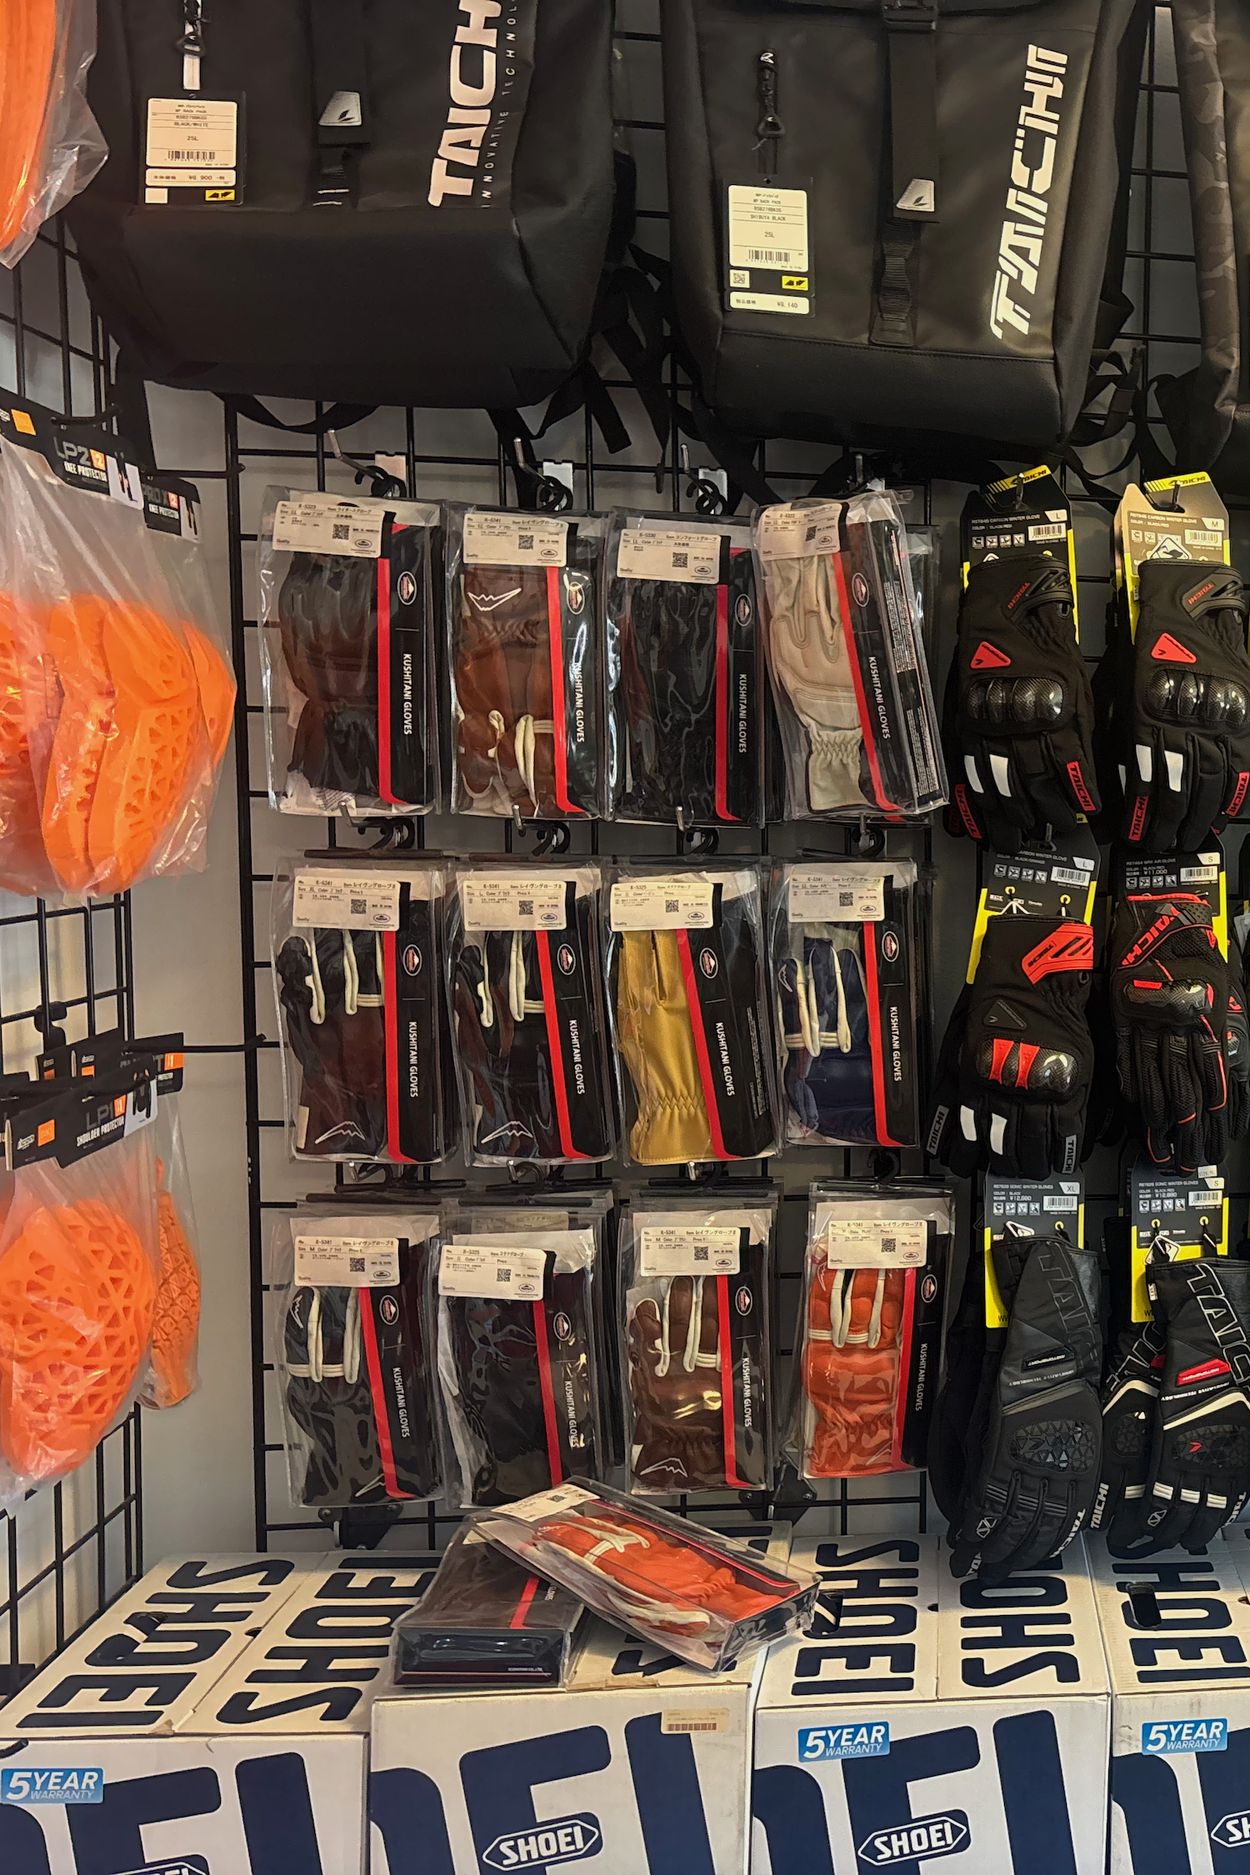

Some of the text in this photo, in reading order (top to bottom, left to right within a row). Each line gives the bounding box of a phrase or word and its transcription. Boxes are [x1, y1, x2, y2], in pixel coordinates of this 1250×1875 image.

[481, 111, 509, 208] INNOVATIVE
[990, 43, 1068, 340] TAICHI
[403, 654, 412, 735] KUSHITANI GLOVES
[576, 710, 584, 742] GLOVES
[739, 674, 747, 753] KUSHITANI GLOVES
[868, 656, 890, 739] KUSHITANI GLOVES
[1070, 764, 1093, 810] TAICHI
[1131, 797, 1146, 840] TAICHI
[1226, 773, 1248, 816] TAICHI
[1028, 944, 1055, 967] TAICHI
[409, 1022, 418, 1097] KUSHITANI GLOVES
[569, 1020, 585, 1094] KUSHITANI GLOVES
[716, 1022, 735, 1096] KUSHITANI GLOVES
[890, 1007, 901, 1081] KUSHITANI GLOVES
[929, 1107, 945, 1155] TAICHI
[1066, 1138, 1077, 1173] TAICHI
[393, 1367, 409, 1438] KUSHITANI GLOVES
[742, 1357, 752, 1427] KUSHITANI GLOVES
[914, 1343, 928, 1411] KUSHITANI GLOVES
[564, 1381, 579, 1448] KUSHITANI GLOVES
[1091, 1483, 1109, 1529] TAICHI
[16, 1558, 295, 1729] SHOEI
[790, 1539, 919, 1696] SHOEI
[825, 1744, 882, 1757] WARRANTY
[1167, 1738, 1220, 1750] WARRANTY
[30, 1789, 94, 1800] WARRANTY
[499, 1825, 588, 1865] SHOEI
[874, 1823, 957, 1863] SHOEI
